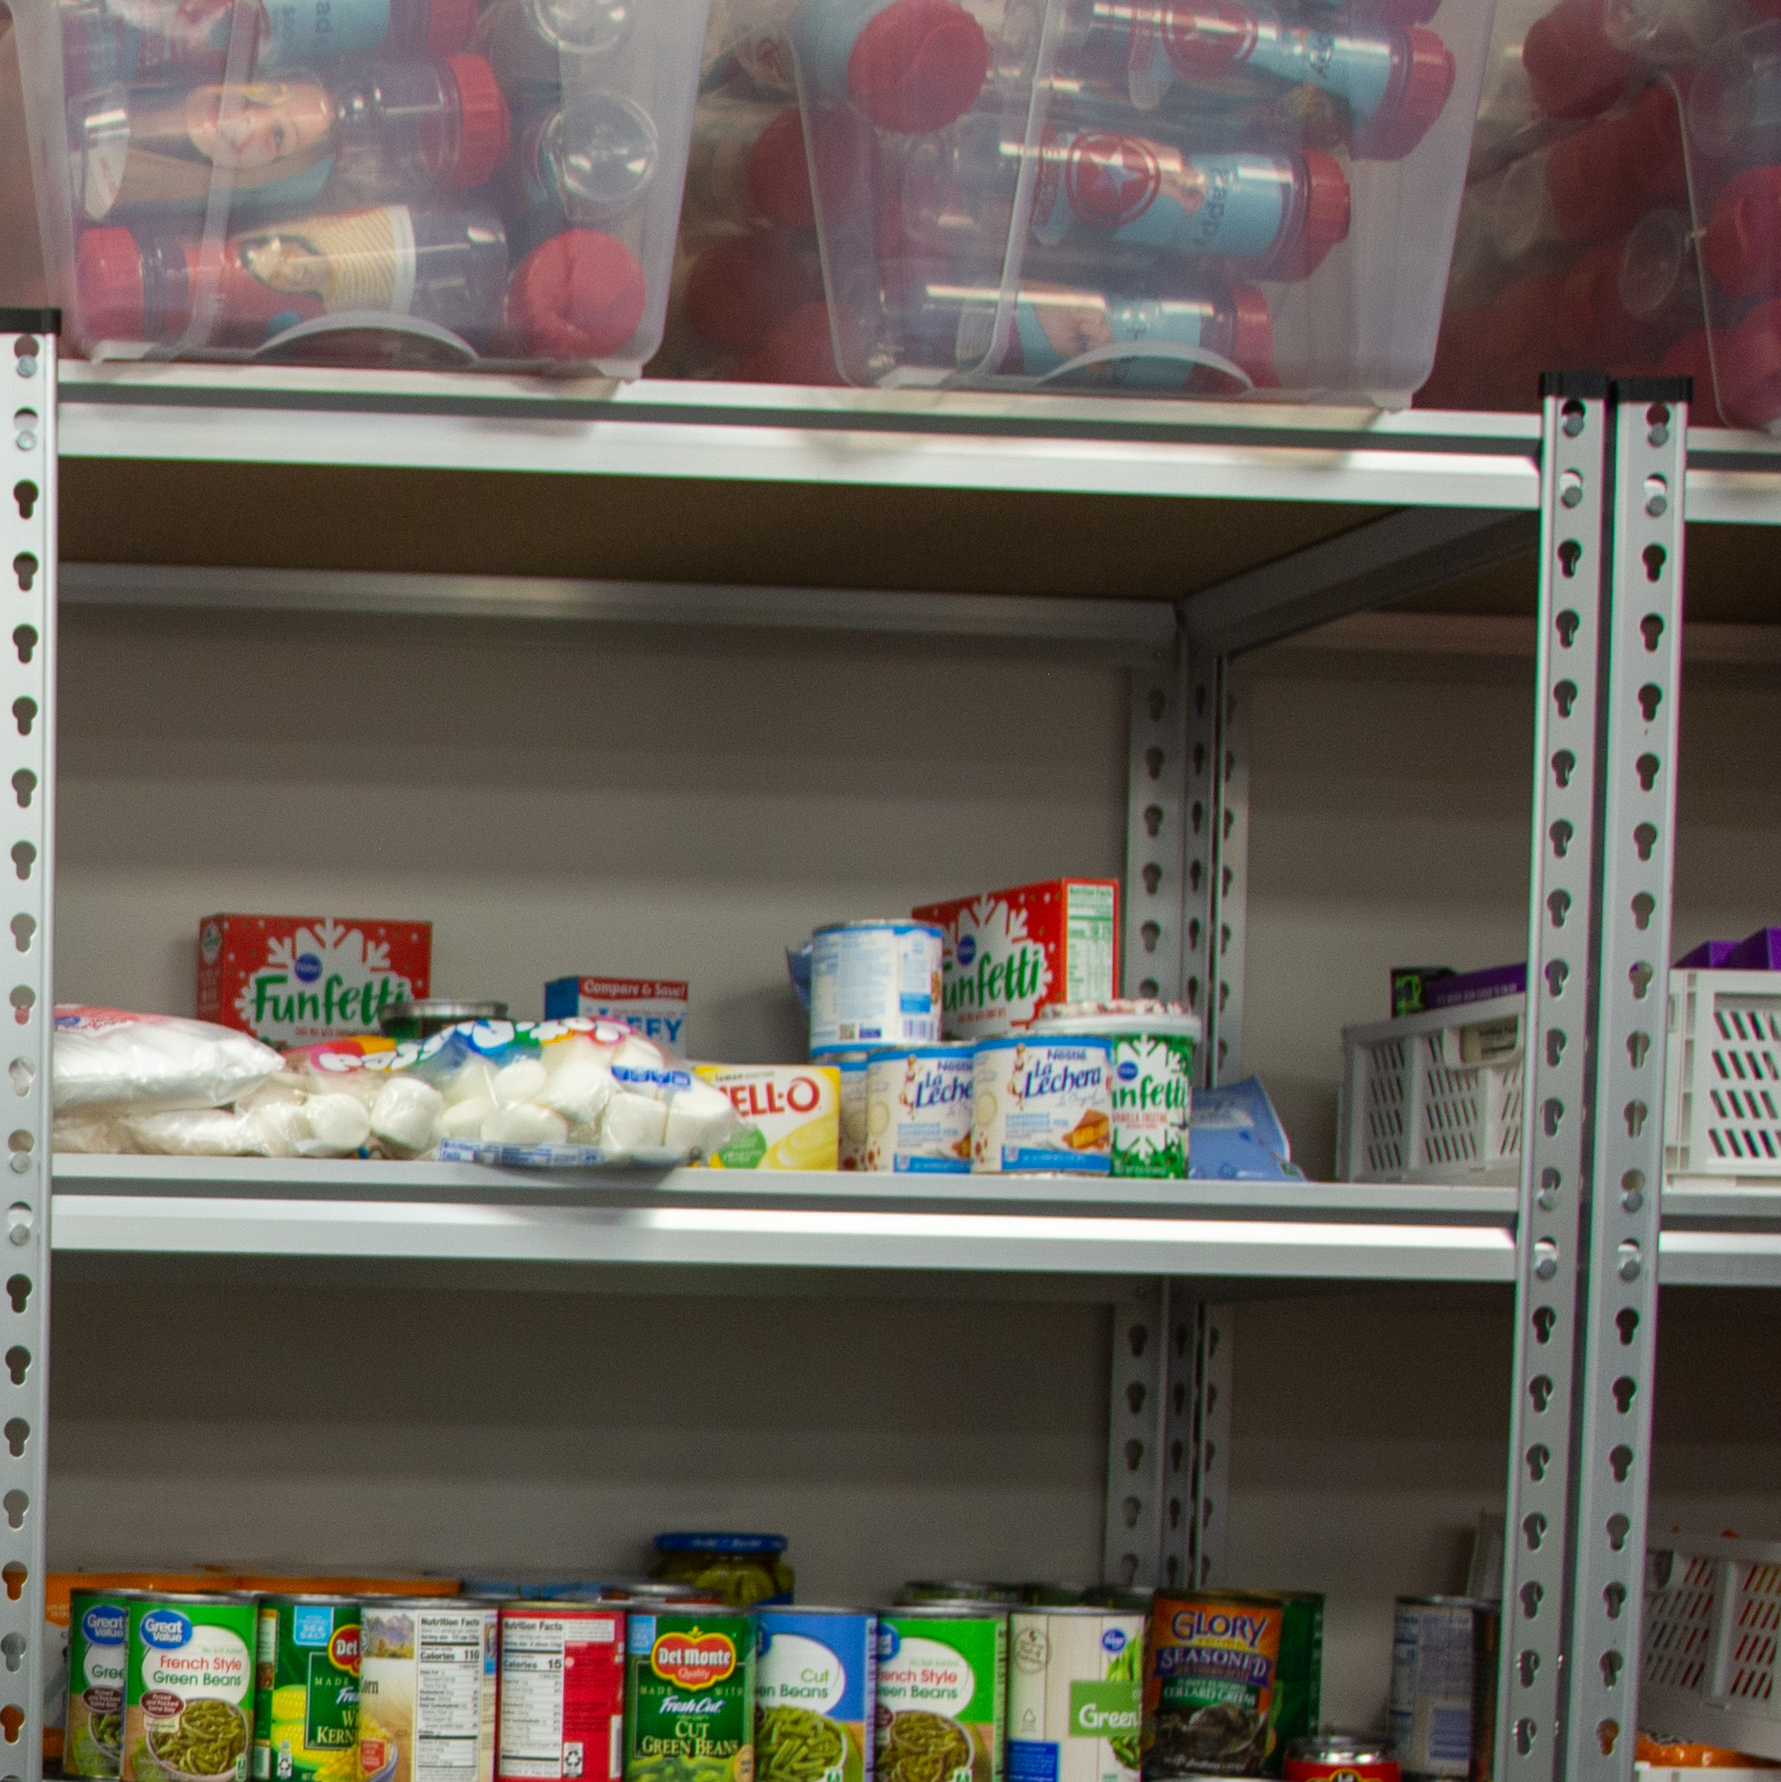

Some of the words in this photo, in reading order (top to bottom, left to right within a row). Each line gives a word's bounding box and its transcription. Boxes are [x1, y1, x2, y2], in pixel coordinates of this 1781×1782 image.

[584, 980, 635, 995] Compare
[640, 983, 649, 995] &
[651, 984, 685, 997] Save!
[250, 975, 405, 1025] Funfetti
[1035, 1060, 1054, 1080] La
[1024, 1068, 1102, 1099] Lechera
[1172, 1611, 1268, 1645] GLORY
[159, 1656, 200, 1671] French
[203, 1656, 243, 1673] Style
[658, 1648, 679, 1664] Del
[681, 1648, 732, 1666] Monte
[153, 1671, 195, 1686] Green
[199, 1672, 242, 1687] Beans
[801, 1668, 829, 1684] Cut
